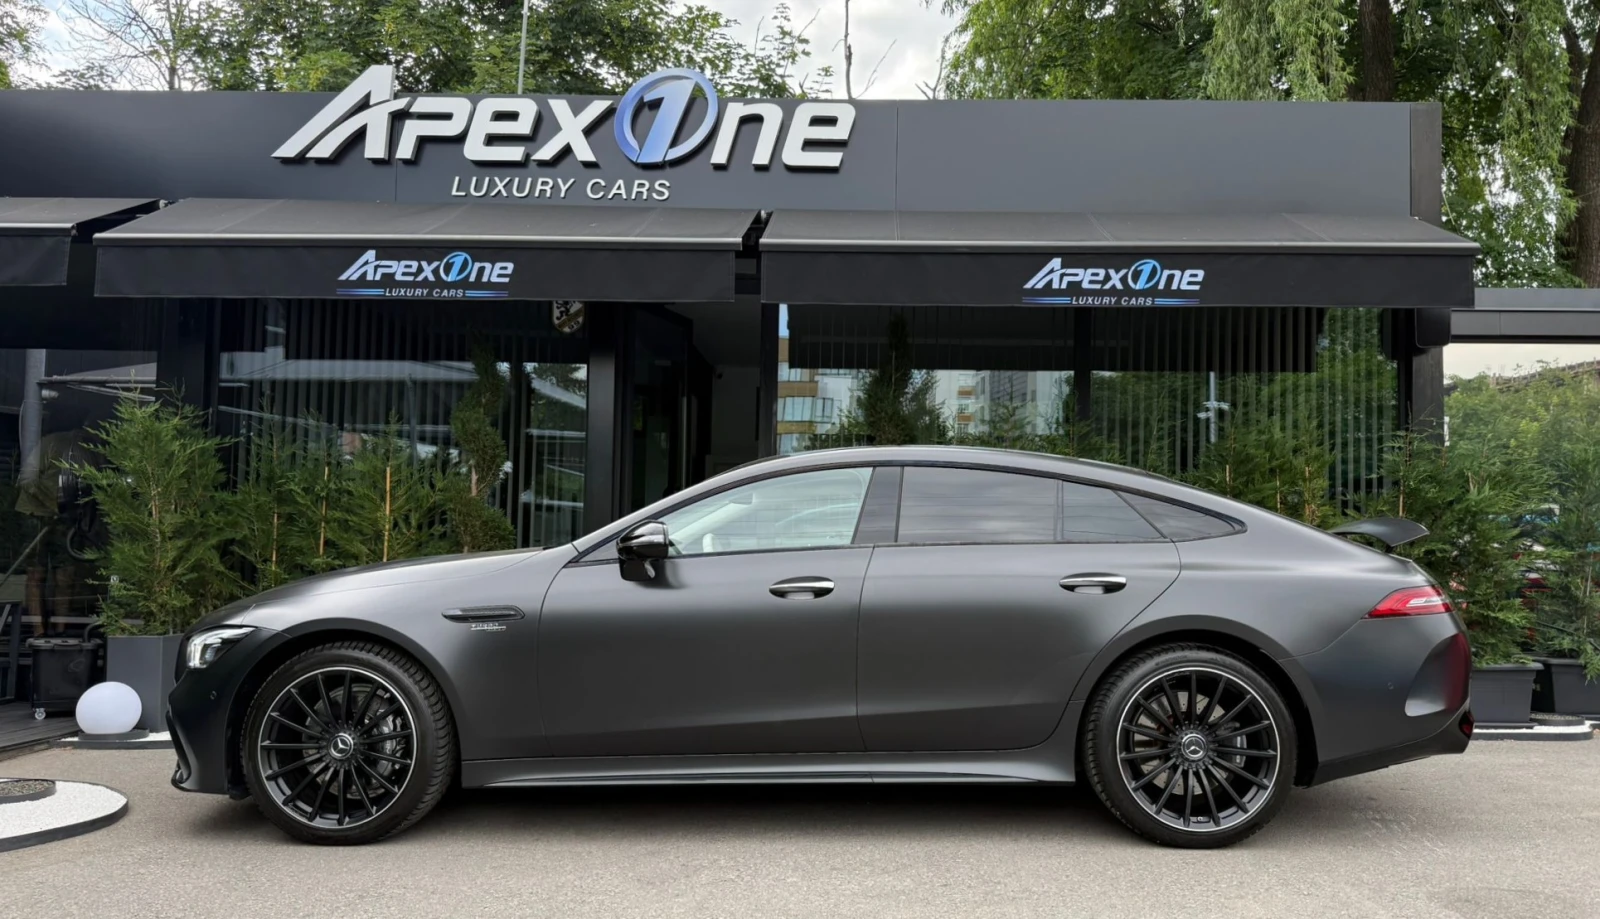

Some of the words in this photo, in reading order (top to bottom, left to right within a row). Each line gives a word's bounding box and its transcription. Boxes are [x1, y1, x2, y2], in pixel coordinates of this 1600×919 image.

[451, 176, 576, 199] LUXURY
[586, 178, 671, 201] CARS
[385, 288, 430, 298] LUXURY
[433, 288, 465, 298] CARS
[1072, 296, 1117, 305] LUXURY
[1121, 297, 1153, 306] CARS
